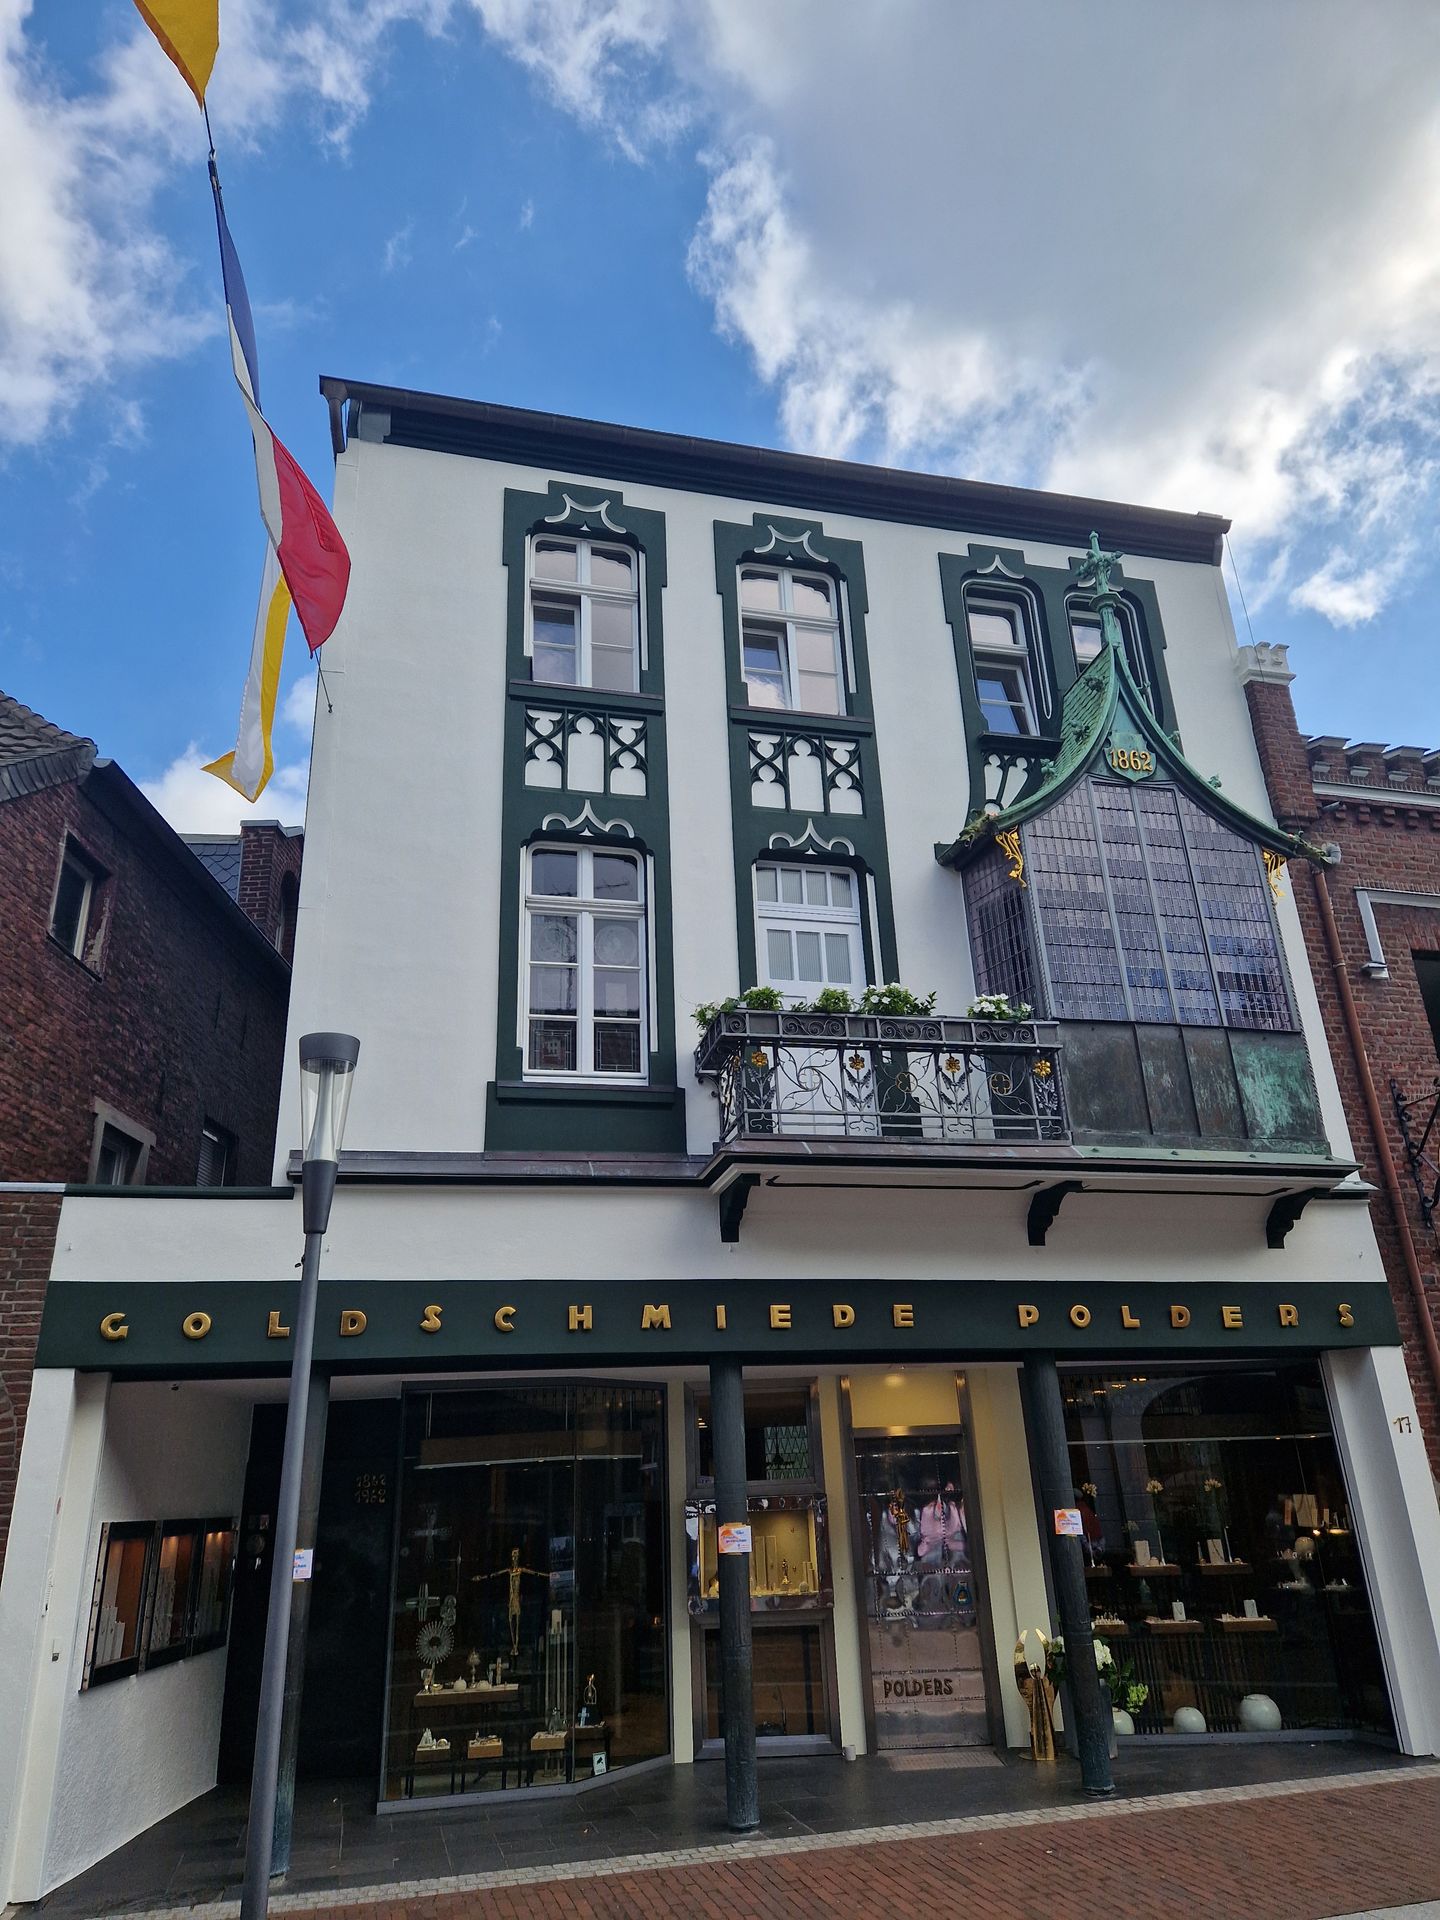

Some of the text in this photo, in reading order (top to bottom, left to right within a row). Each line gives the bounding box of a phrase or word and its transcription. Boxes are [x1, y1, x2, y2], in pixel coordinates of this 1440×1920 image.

[1109, 748, 1153, 772] 1862
[99, 1303, 1355, 1340] GOLDSCHMIEDE POLDERS
[1392, 1416, 1412, 1434] 17
[883, 1678, 953, 1698] POLDERS
